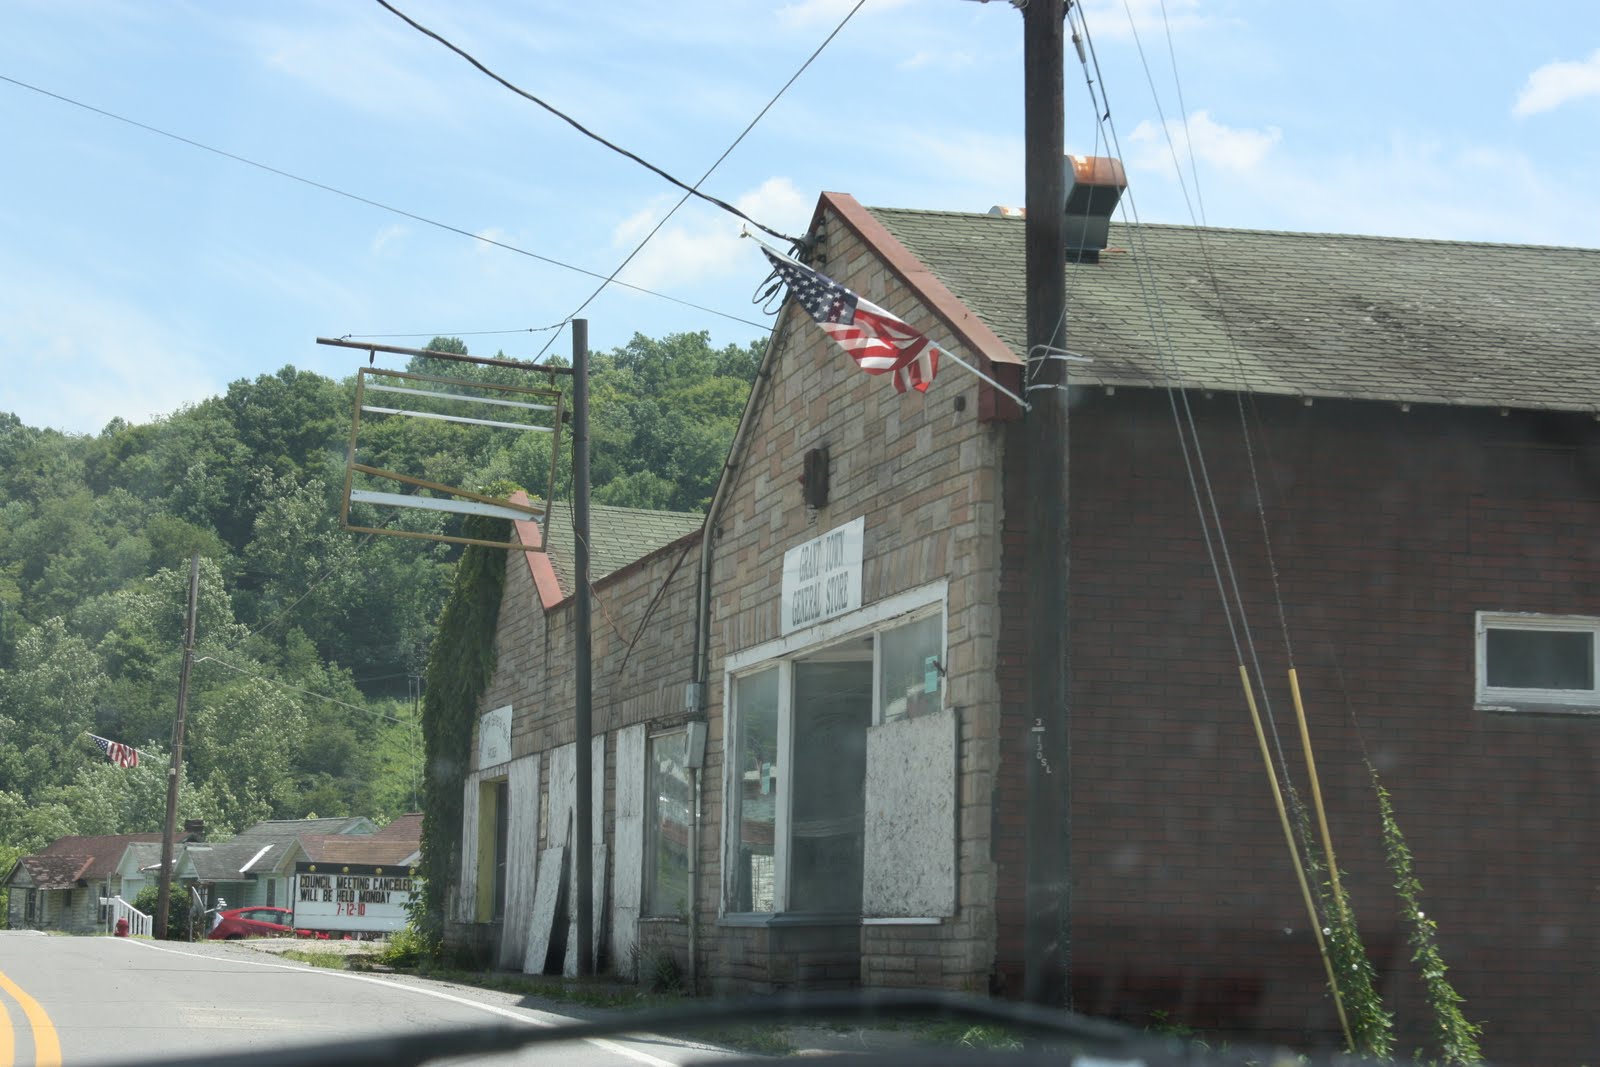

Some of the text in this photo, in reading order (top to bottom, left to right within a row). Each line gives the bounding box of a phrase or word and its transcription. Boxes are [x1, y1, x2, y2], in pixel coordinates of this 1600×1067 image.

[792, 571, 848, 626] GENERAL STORE
[300, 875, 331, 889] COUNCIL
[337, 876, 369, 890] MEETING
[300, 889, 391, 904] WILL BE HELD MONDAY
